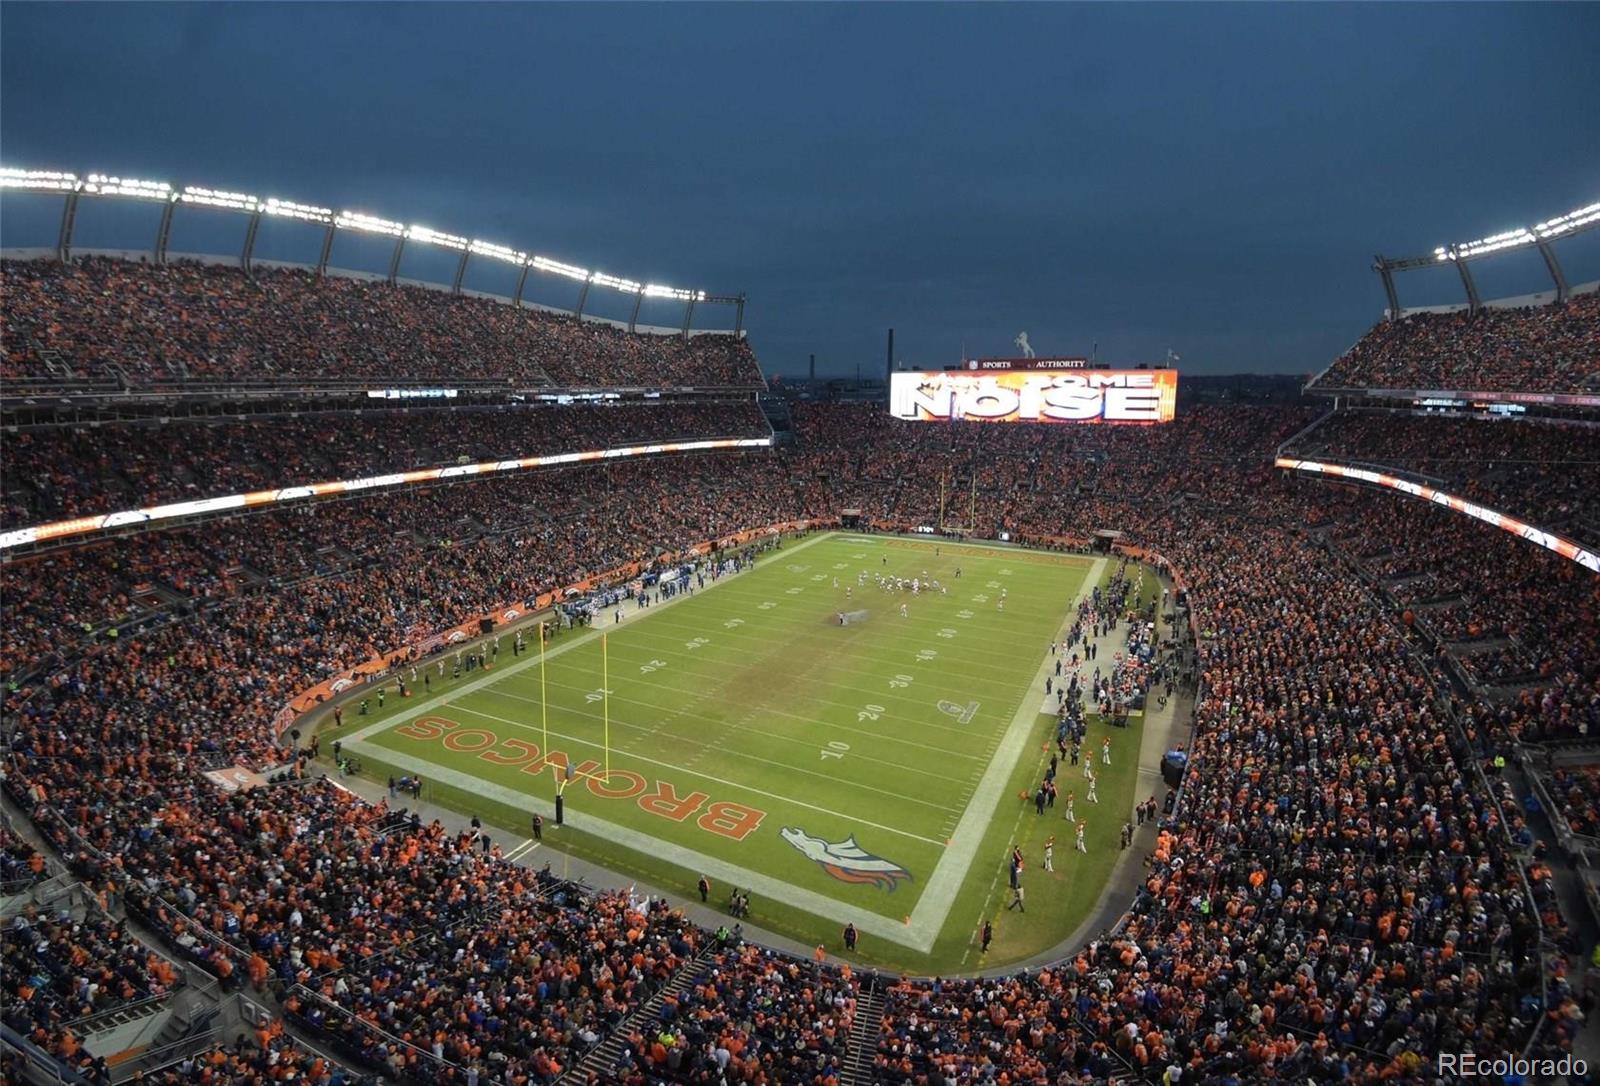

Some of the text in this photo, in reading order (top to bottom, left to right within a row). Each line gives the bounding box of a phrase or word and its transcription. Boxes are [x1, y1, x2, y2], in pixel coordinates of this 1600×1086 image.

[1036, 360, 1086, 368] AUTHORITY
[899, 382, 1161, 421] NOISE
[890, 674, 913, 688] 30
[859, 704, 885, 720] 20
[822, 741, 850, 759] 10
[394, 716, 768, 842] BRONCOS
